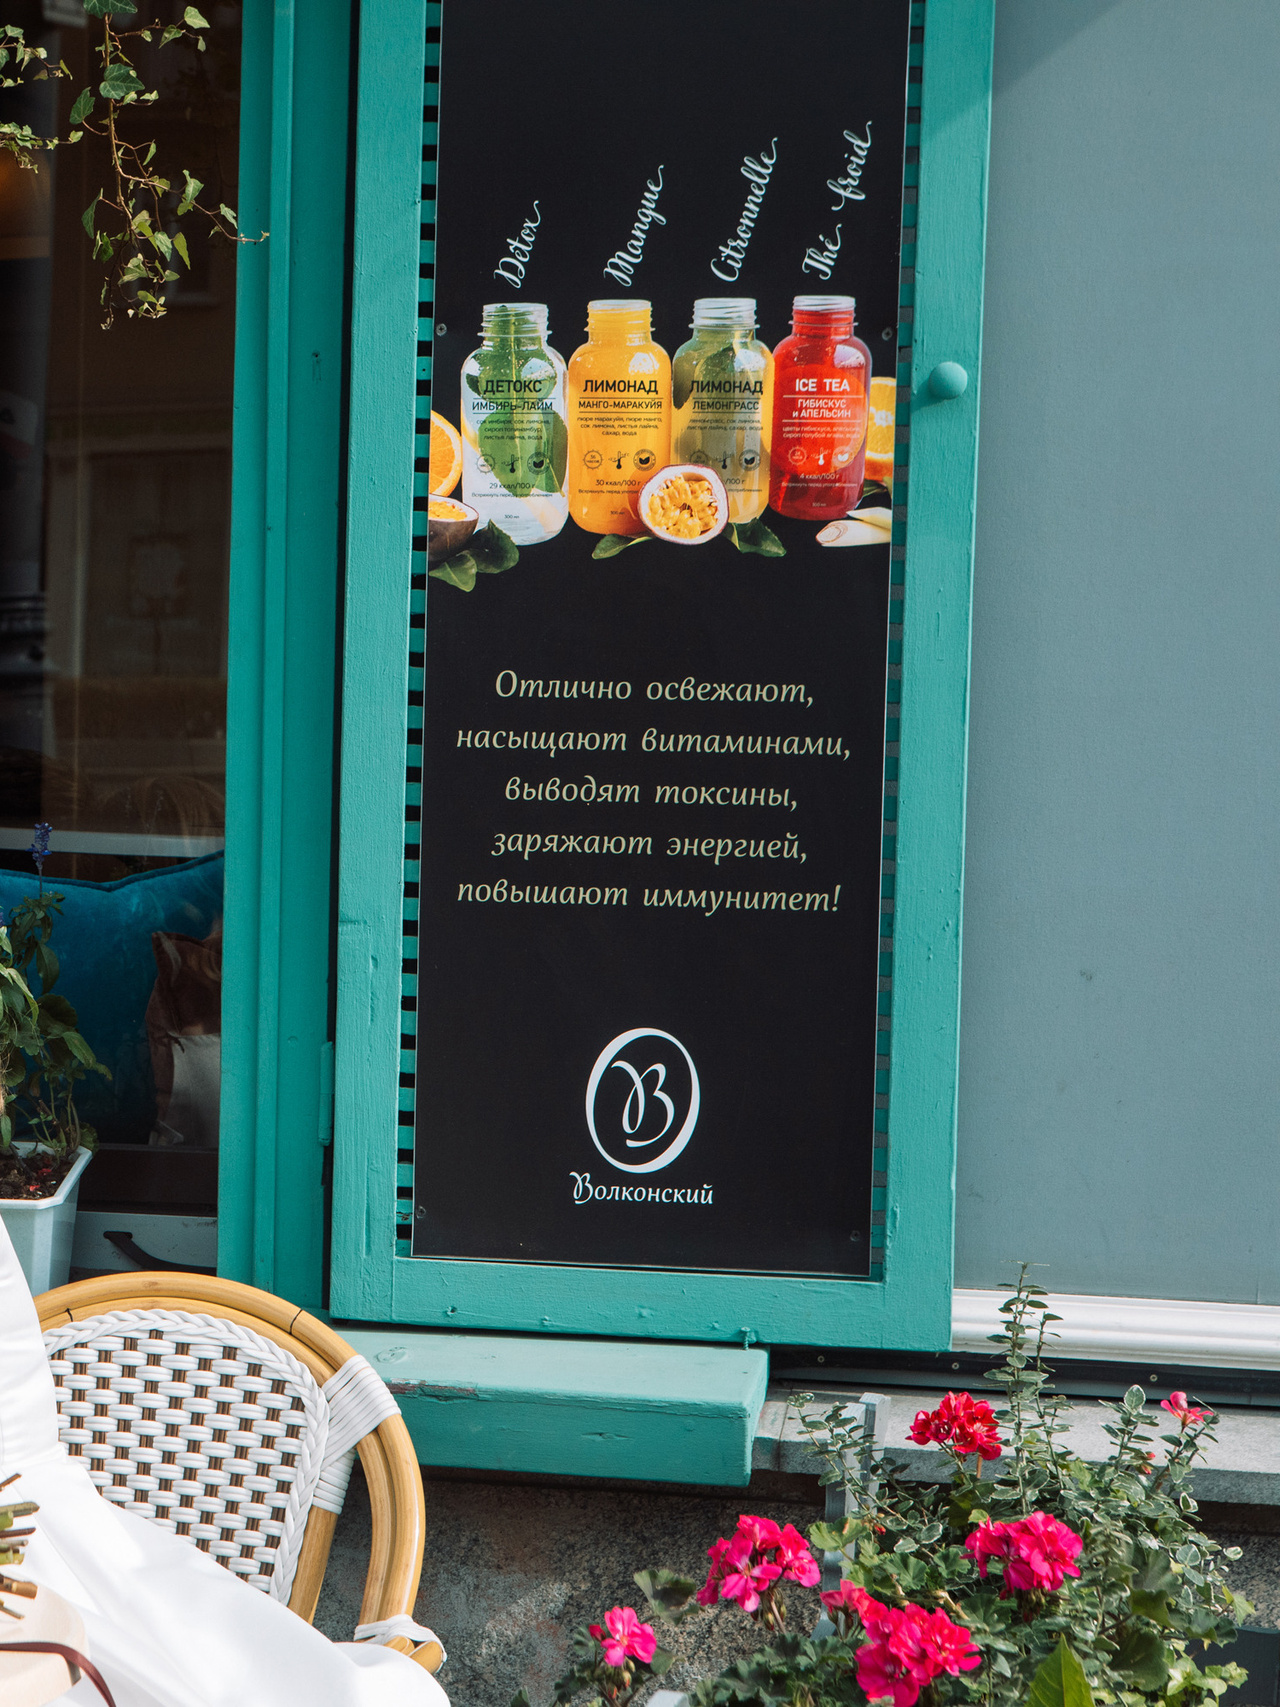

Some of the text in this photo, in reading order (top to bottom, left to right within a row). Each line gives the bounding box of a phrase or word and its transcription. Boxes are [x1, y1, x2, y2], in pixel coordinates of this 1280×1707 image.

[710, 136, 778, 282] Citronnelle
[801, 120, 872, 280] Thé froid
[603, 164, 666, 287] Mangue
[483, 379, 542, 395] ДЕТОКС
[583, 379, 658, 395] ЛИМОНАД
[689, 380, 763, 395] ЛИМОНАД
[795, 378, 850, 392] ICE TEA
[472, 399, 553, 411] ИМБИРЬ-ЛАЙМ
[578, 398, 662, 409] МАНГО-МАРАКУЙЯ
[692, 400, 759, 410] ЛЕМОНГРАСС
[797, 399, 846, 408] ГИБИСКУС
[800, 409, 851, 418] АПЕЛЬСИН
[495, 669, 814, 708] Отлично освежают,
[456, 727, 850, 761] насыщают витаминами,
[505, 774, 798, 812] выводят токсины,
[490, 831, 807, 866] заряжают энергией,
[457, 879, 842, 917] повышают иммунитет!
[569, 1170, 714, 1206] Волконский
